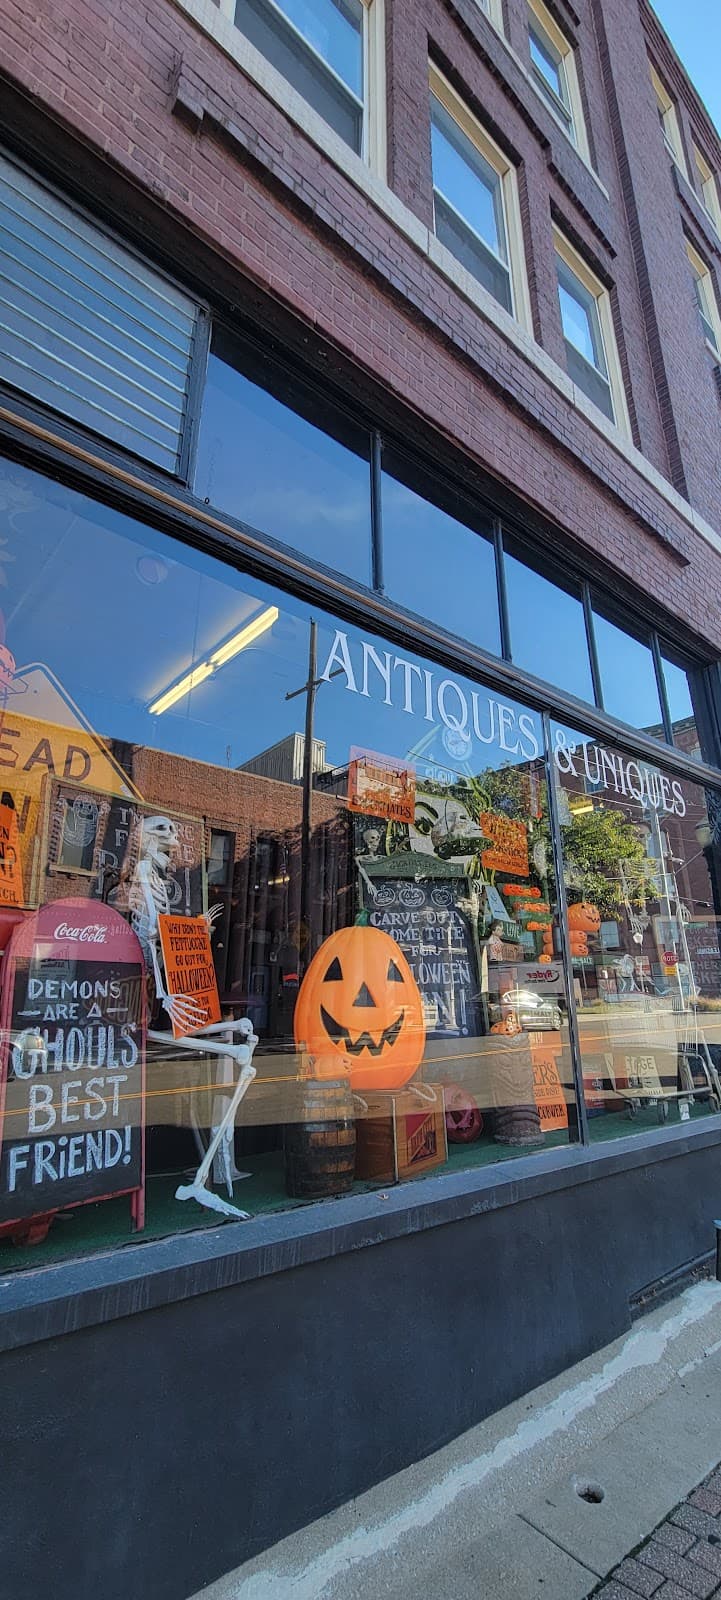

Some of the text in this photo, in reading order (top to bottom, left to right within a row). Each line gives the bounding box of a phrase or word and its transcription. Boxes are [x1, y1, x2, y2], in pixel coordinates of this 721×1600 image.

[320, 629, 687, 818] ANTIQUES & UNIQUES
[370, 911, 420, 926] CARVE
[54, 922, 107, 944] Coca-Cola
[384, 927, 420, 942] OME
[28, 978, 121, 1000] DEMONS
[42, 1003, 102, 1022] ARE A
[12, 1023, 139, 1080] GHOULS
[28, 1075, 129, 1134] BEST
